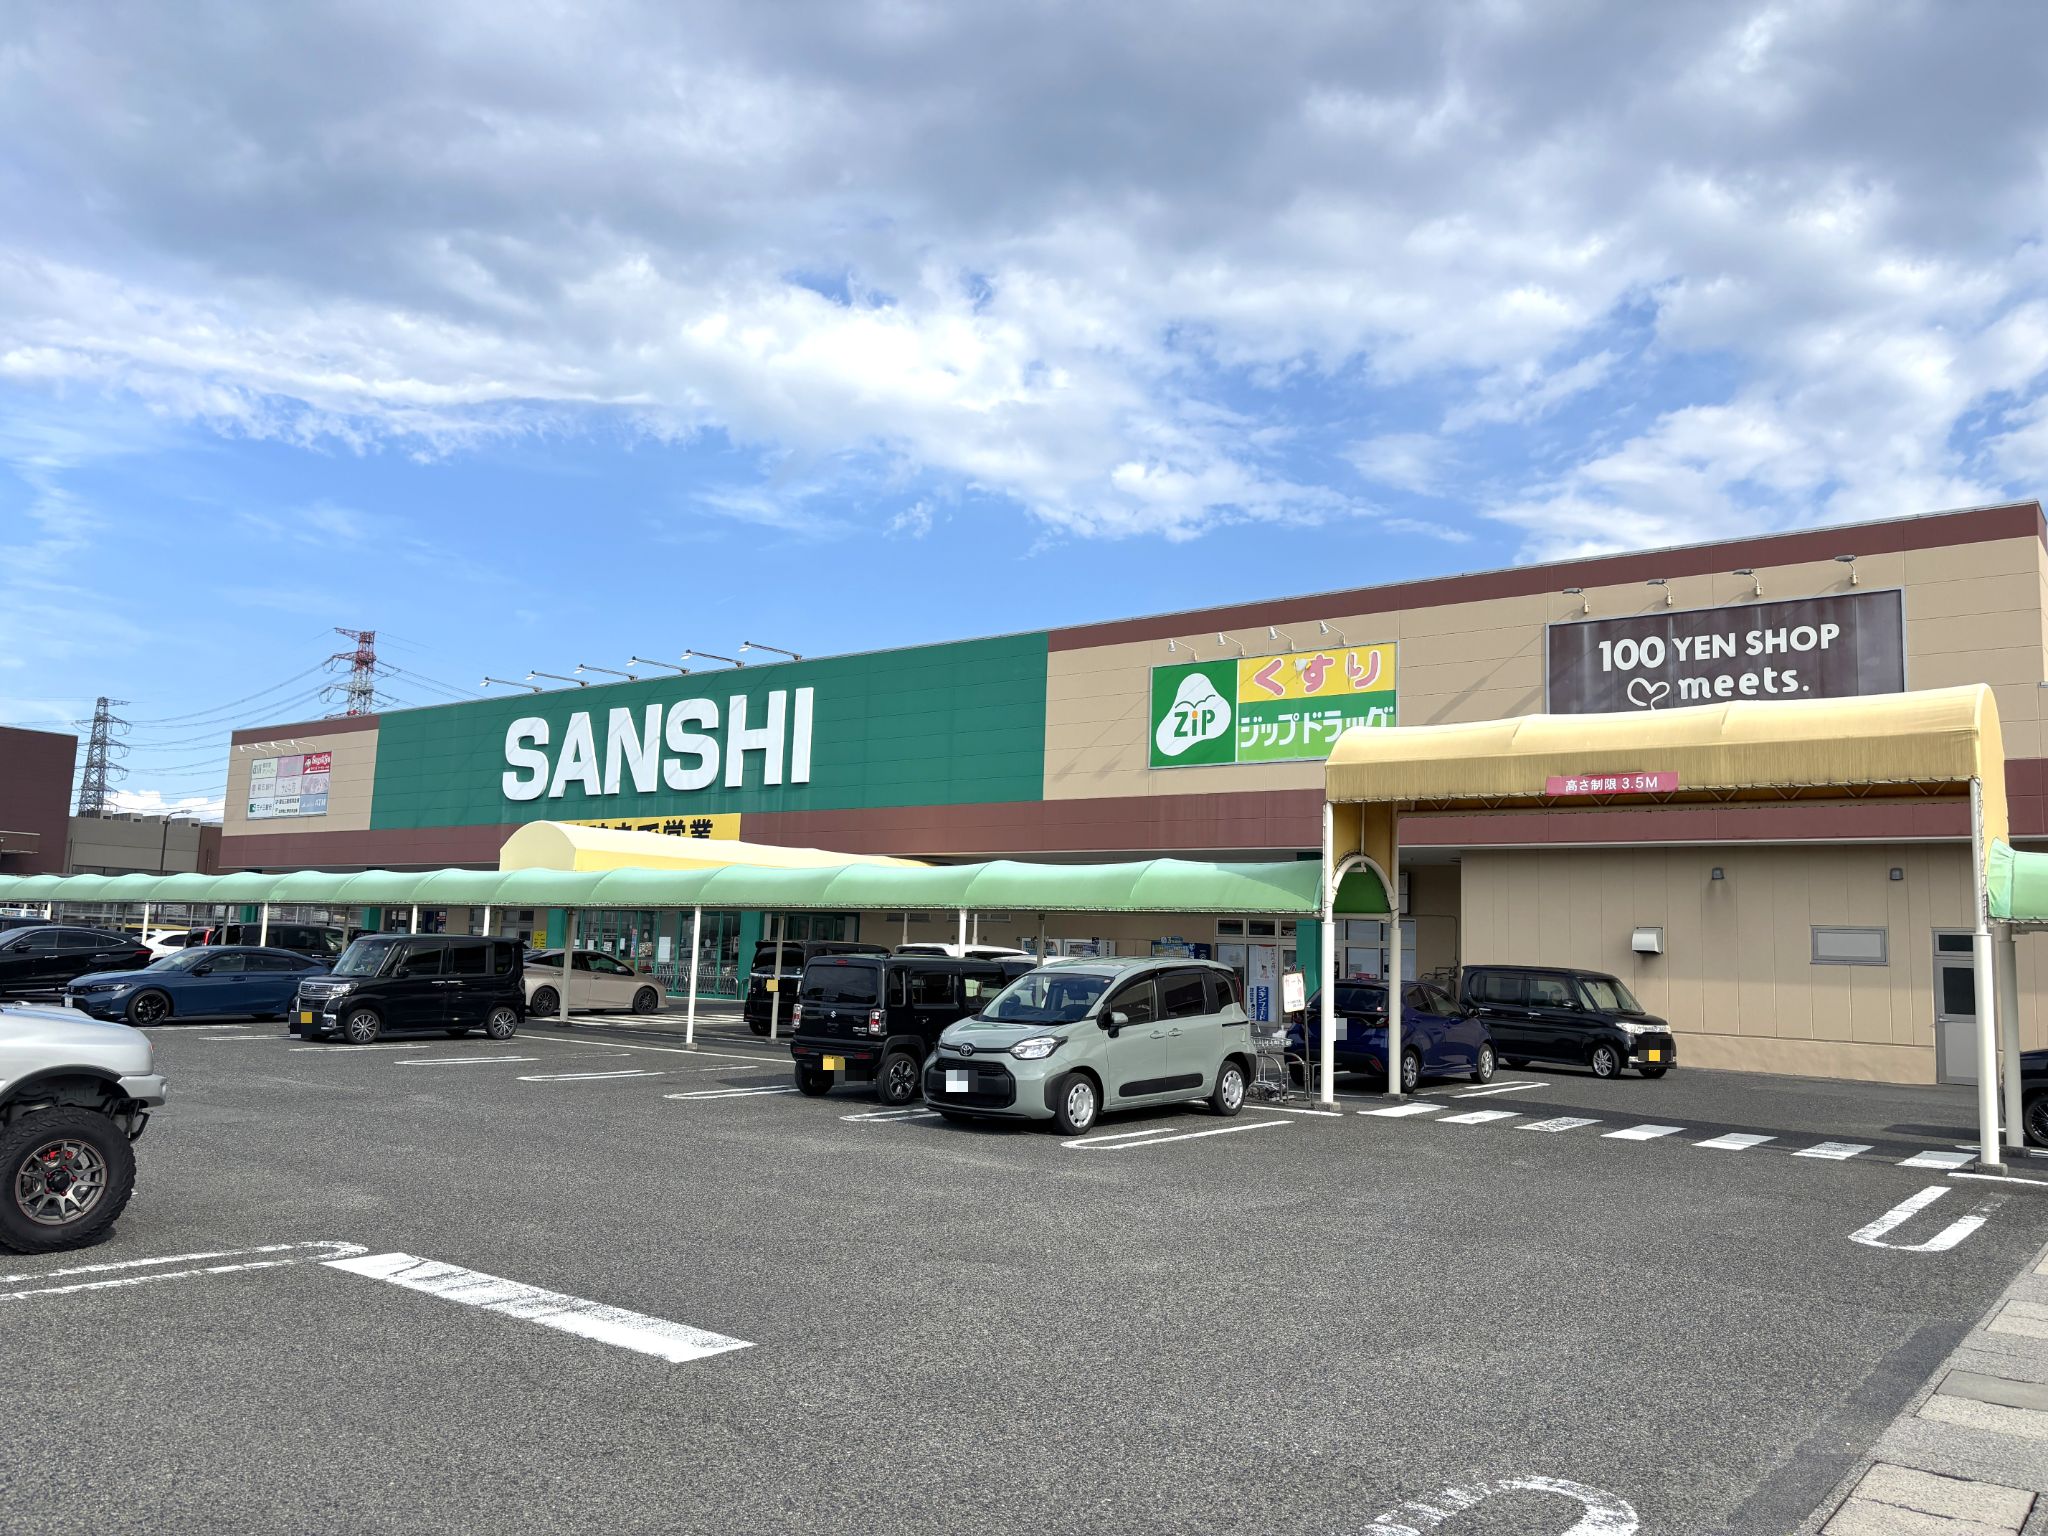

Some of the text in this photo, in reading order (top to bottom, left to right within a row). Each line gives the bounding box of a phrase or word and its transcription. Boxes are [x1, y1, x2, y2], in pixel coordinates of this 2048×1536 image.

[1598, 623, 1840, 672] 100 YEN SHOP
[1254, 650, 1380, 696] くすり
[1678, 667, 1809, 700] meets.
[502, 687, 814, 801] SANSHI
[1565, 776, 1658, 792] 高さ制限 3.5M
